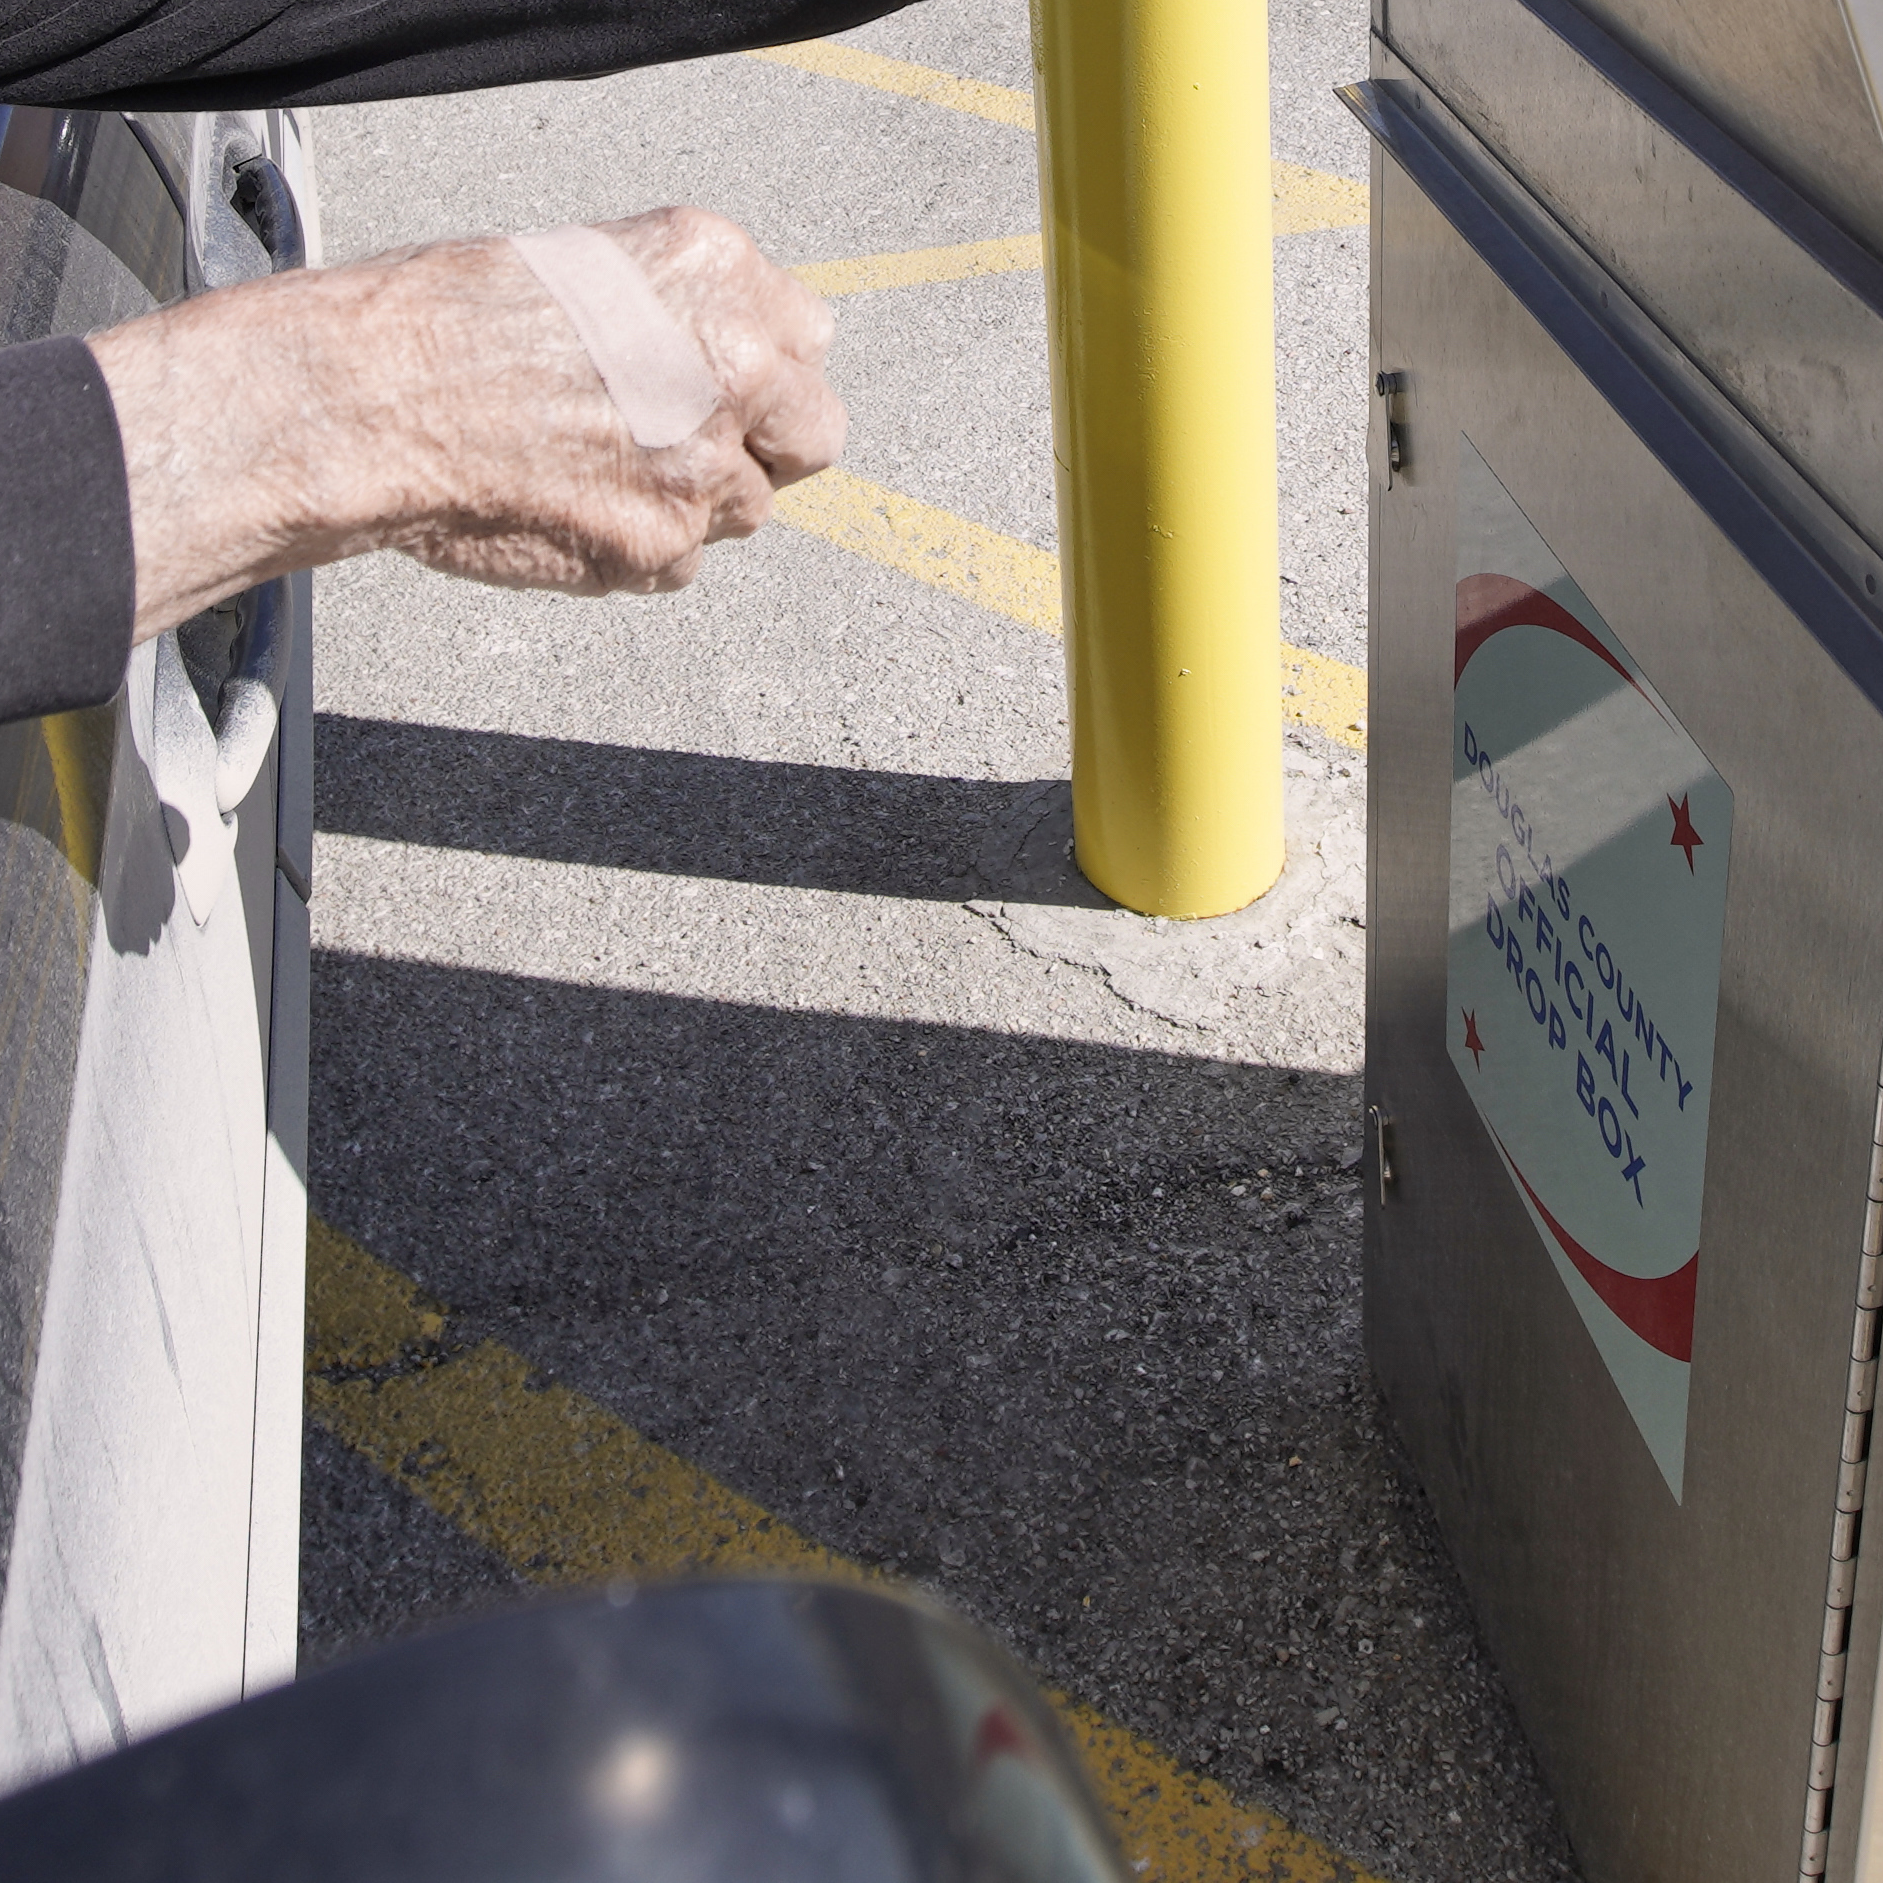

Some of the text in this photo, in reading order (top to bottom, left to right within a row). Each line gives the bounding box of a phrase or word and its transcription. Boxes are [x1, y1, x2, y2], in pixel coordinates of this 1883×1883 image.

[1464, 720, 1693, 1113] DOUGLAS COUNTY
[1486, 891, 1647, 1210] DROP BOX
[1495, 843, 1639, 1120] OFFICIAL
